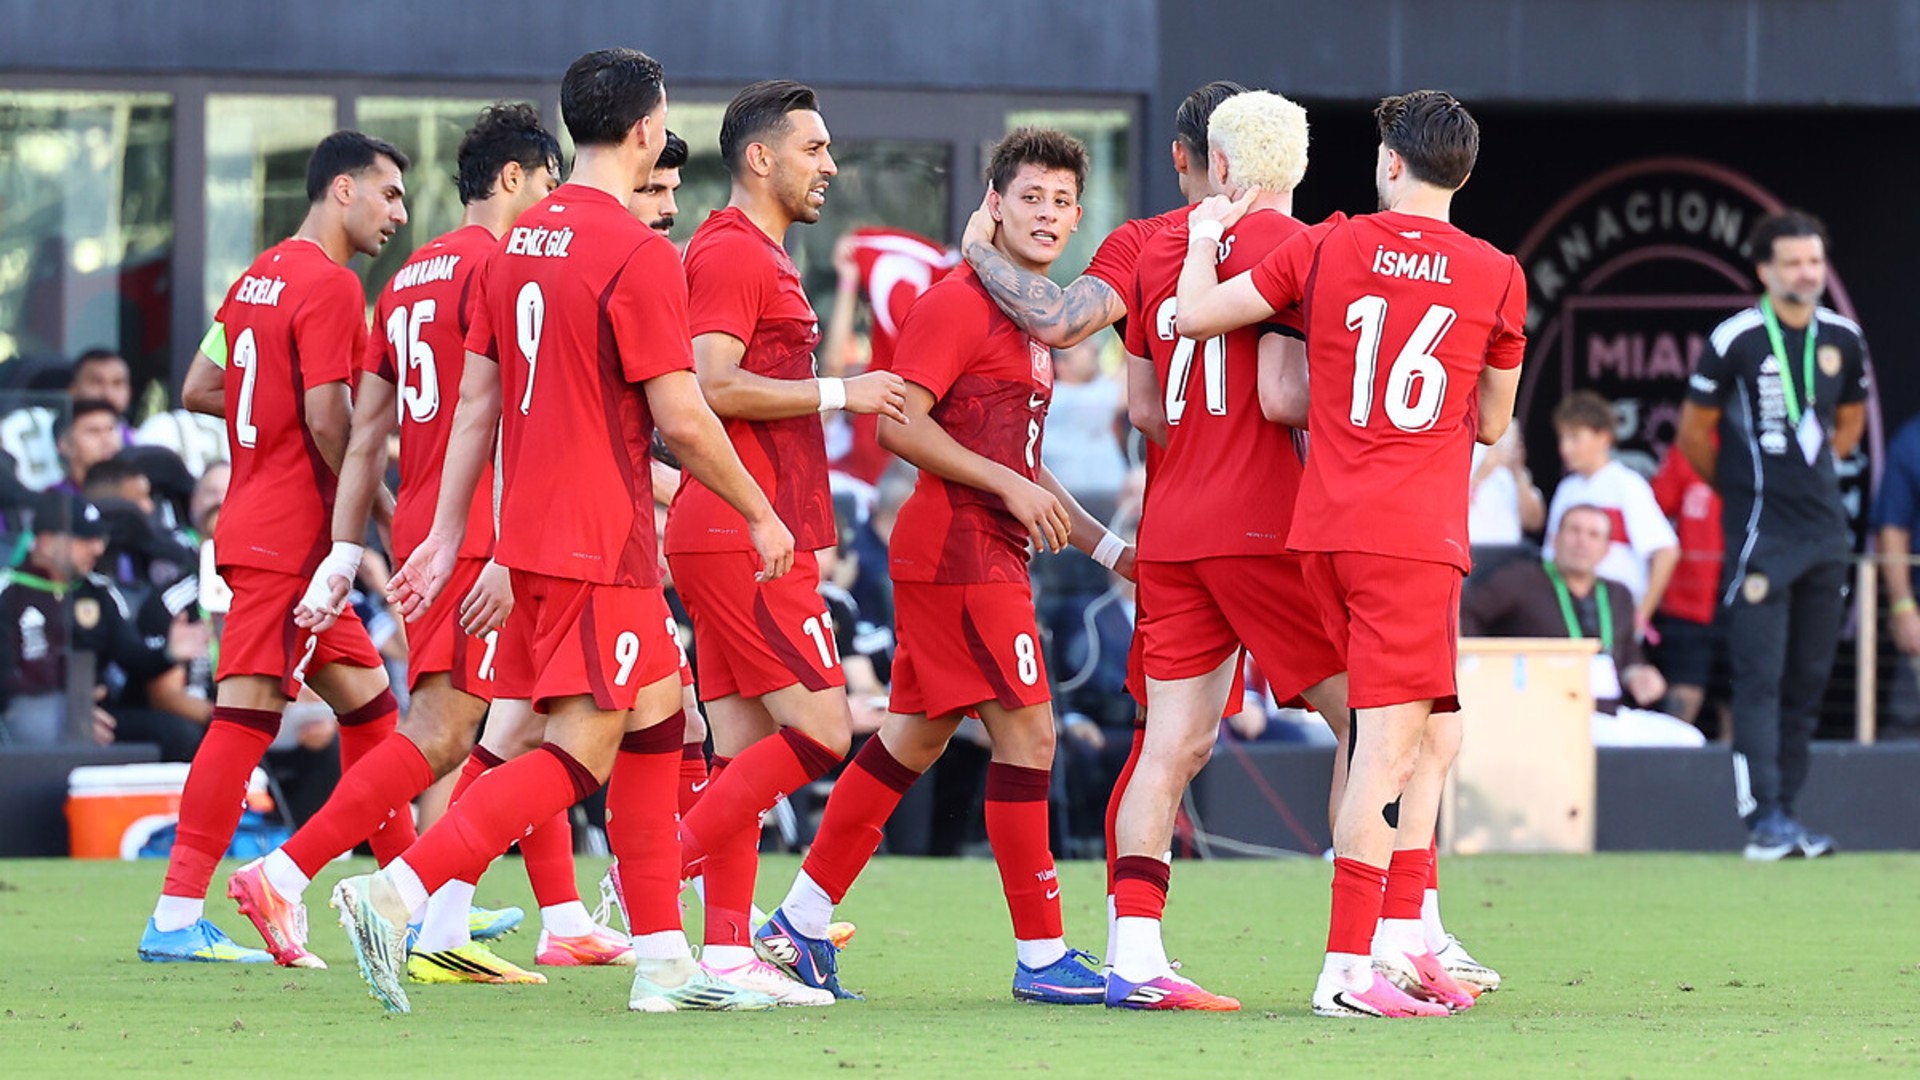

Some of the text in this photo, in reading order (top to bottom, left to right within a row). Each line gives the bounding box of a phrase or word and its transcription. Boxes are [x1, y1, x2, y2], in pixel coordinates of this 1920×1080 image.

[1371, 244, 1453, 285] İSMAİL
[233, 328, 258, 449] 2
[387, 299, 440, 426] 15
[515, 281, 544, 416] 9
[1156, 296, 1227, 426] 21
[1345, 294, 1458, 433] 16
[293, 634, 317, 682] 2
[614, 631, 640, 686] 9
[1014, 632, 1039, 686] 8
